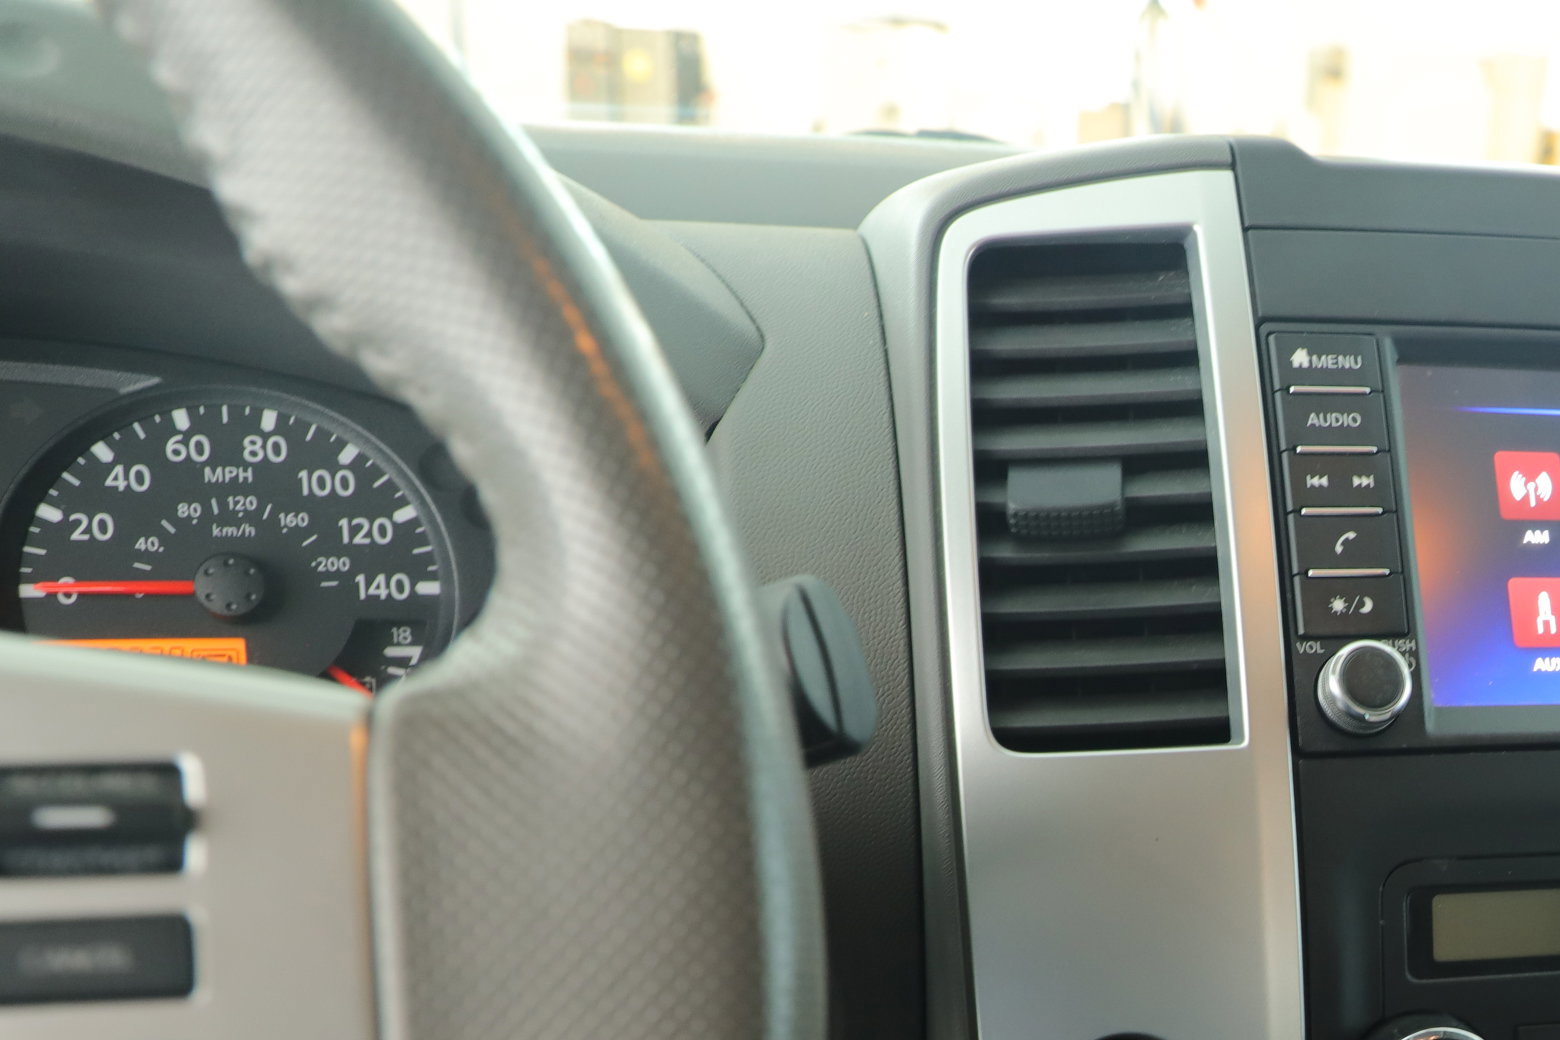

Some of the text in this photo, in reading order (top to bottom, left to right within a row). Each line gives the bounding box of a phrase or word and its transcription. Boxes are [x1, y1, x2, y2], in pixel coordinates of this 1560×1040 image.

[1312, 354, 1362, 369] MENU
[1307, 412, 1361, 427] AUDIO
[166, 435, 210, 462] 60
[242, 435, 287, 463] 80
[105, 465, 150, 492] 40
[204, 467, 252, 483] MPH
[298, 470, 355, 497] 100
[177, 502, 201, 518] 80
[227, 496, 257, 511] 120
[69, 513, 113, 540] 20
[279, 512, 309, 528] 160
[212, 522, 255, 537] km/h
[338, 517, 393, 545] 120
[1523, 530, 1550, 545] AM
[135, 536, 158, 552] 40
[317, 556, 350, 572] 200
[355, 573, 410, 600] 140
[391, 626, 412, 644] 18
[1296, 641, 1325, 654] VOL
